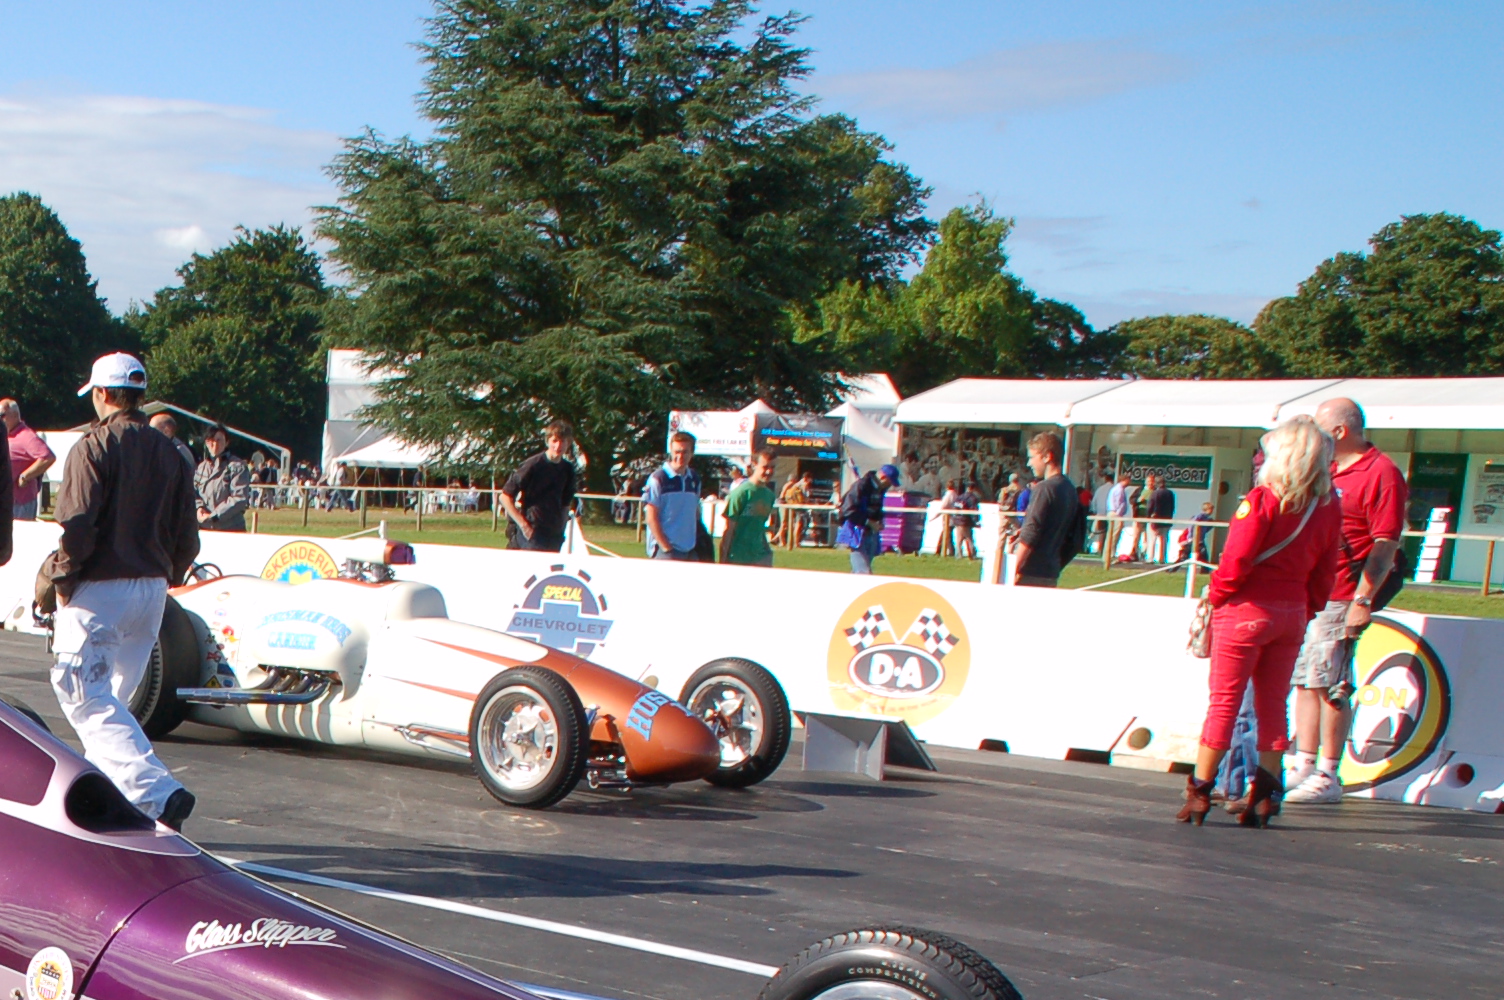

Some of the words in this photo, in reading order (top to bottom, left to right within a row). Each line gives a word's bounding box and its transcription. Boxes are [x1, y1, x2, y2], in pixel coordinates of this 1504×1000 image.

[265, 546, 334, 580] SKENDERIA
[542, 585, 583, 602] SPECIAL
[512, 616, 608, 636] CHEVROLET
[1357, 684, 1408, 709] ON
[185, 919, 243, 953] Glass
[242, 917, 337, 948] Slipper
[848, 967, 937, 999] COMPETITION
